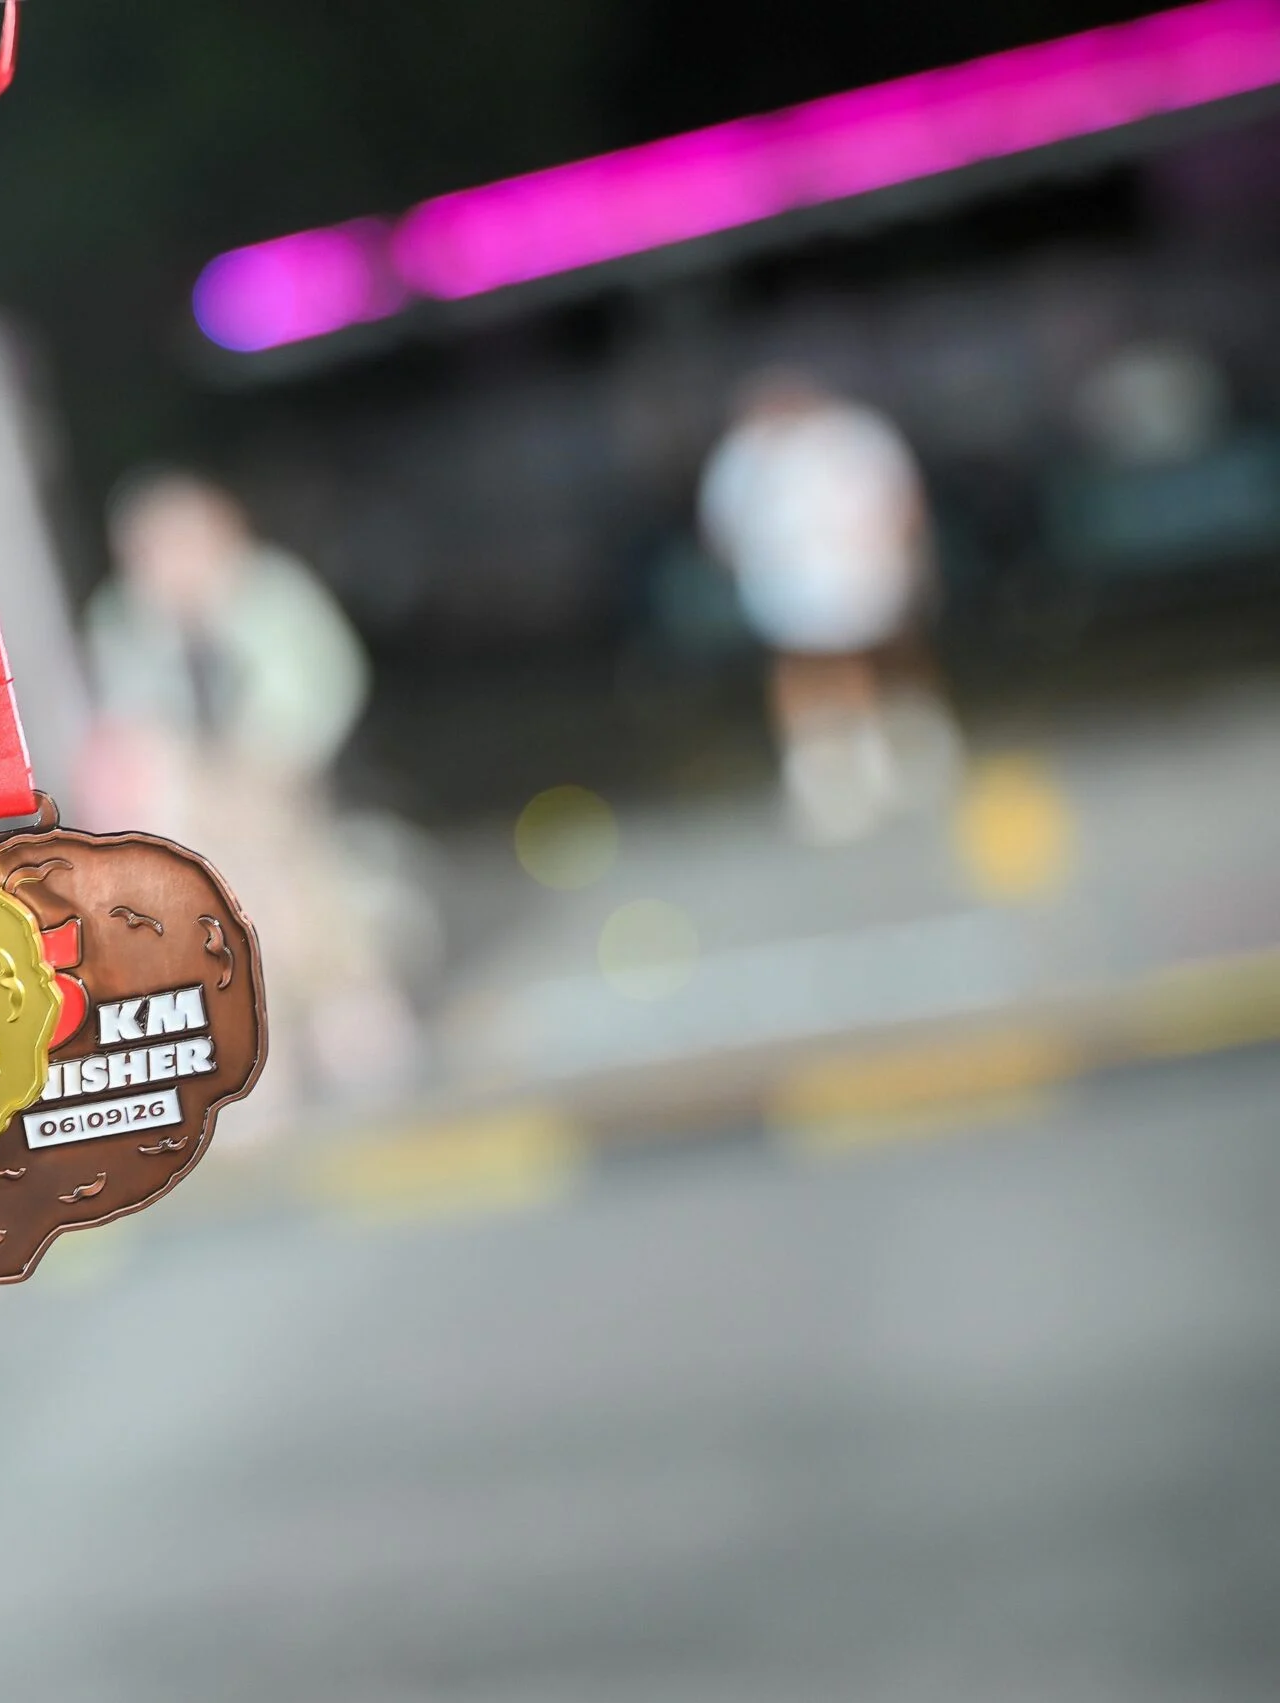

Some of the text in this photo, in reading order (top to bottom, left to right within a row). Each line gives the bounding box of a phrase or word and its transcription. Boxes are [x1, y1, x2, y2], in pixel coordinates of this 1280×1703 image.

[98, 986, 208, 1046] KM
[41, 1036, 216, 1101] ISHER
[39, 1100, 166, 1137] 06|09|26
